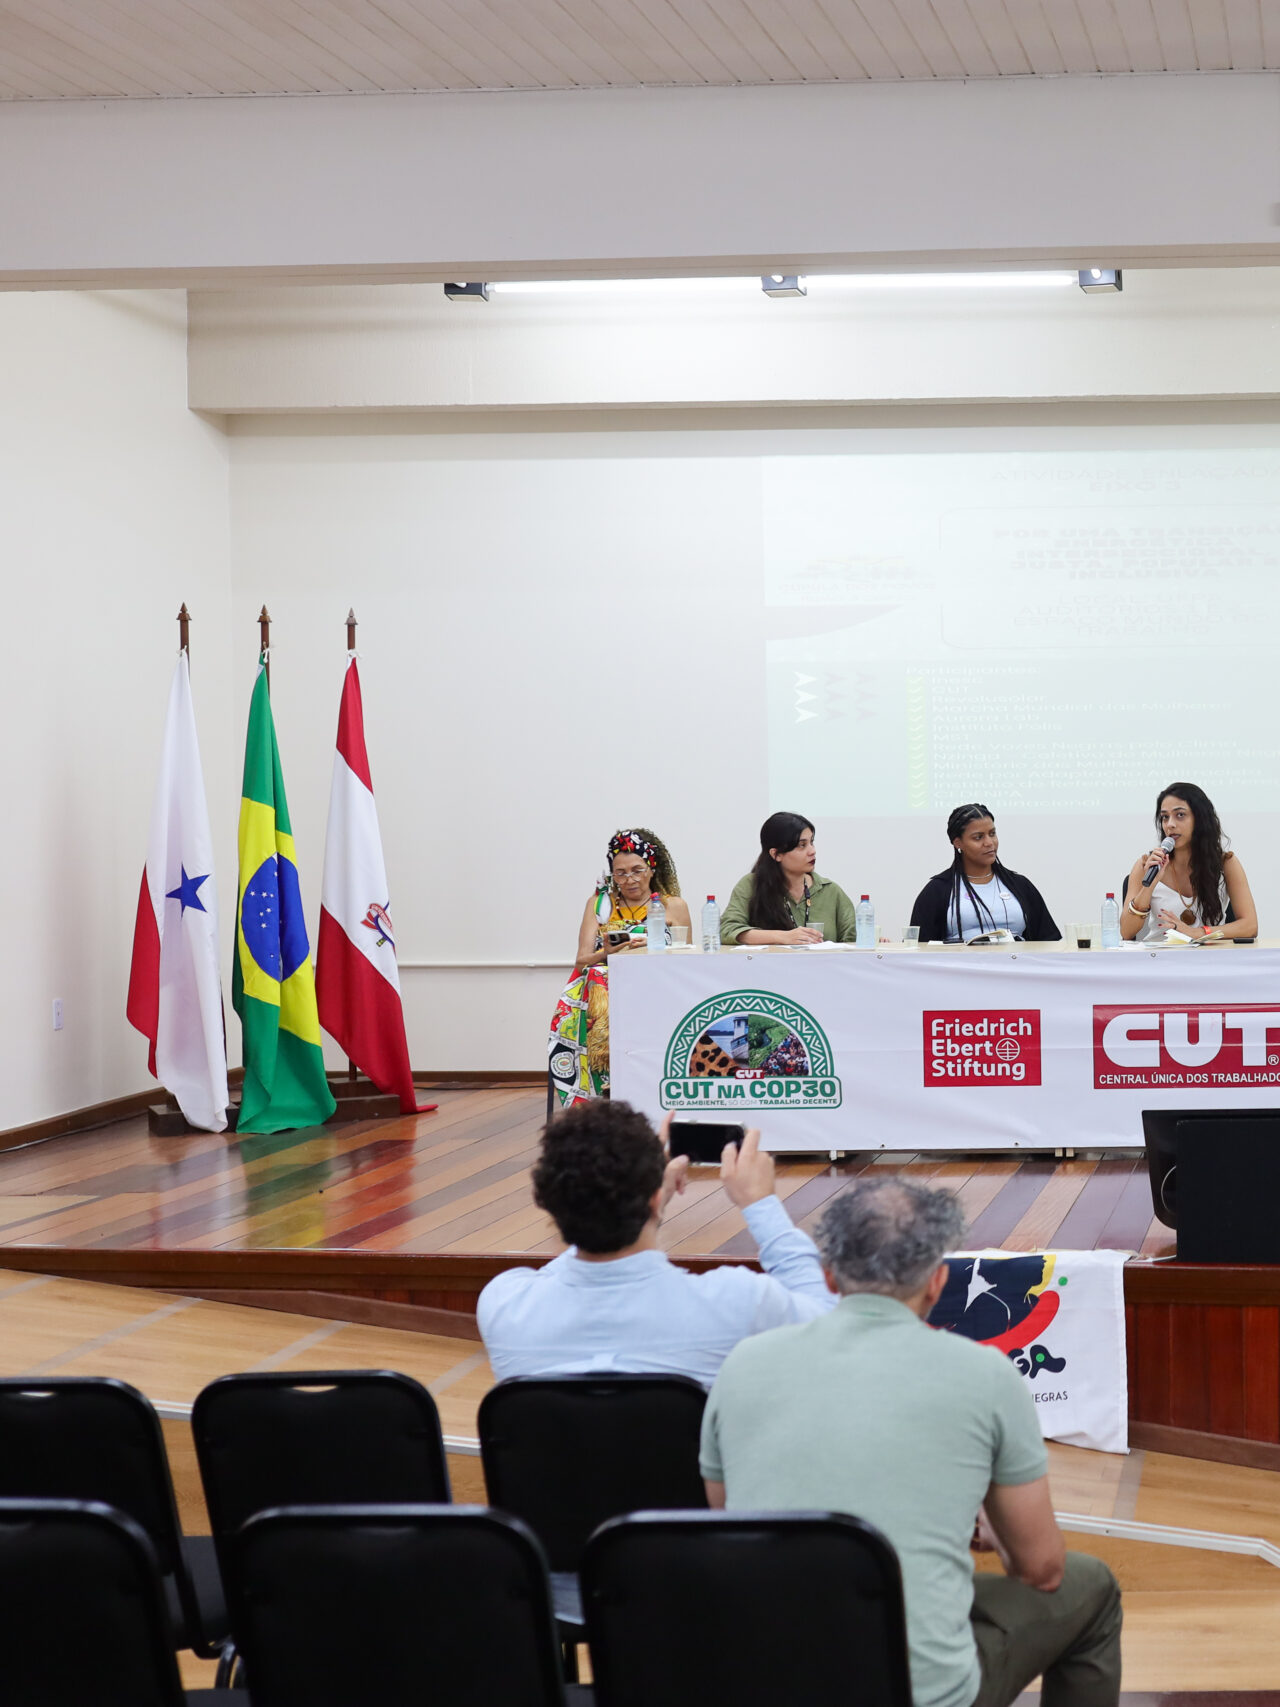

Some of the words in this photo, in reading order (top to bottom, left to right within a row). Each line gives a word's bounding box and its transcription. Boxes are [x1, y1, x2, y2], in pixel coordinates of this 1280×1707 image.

[993, 529, 1051, 539] POR
[1060, 527, 1121, 538] UMA
[1122, 558, 1253, 569] POPULAR
[1069, 568, 1222, 580] INCLUSIVA
[931, 686, 969, 695] CUT
[932, 704, 1008, 713] Marcha
[1013, 703, 1094, 712] Mundial
[933, 723, 1012, 732] Instituto
[933, 743, 983, 751] Rede
[931, 1017, 1032, 1036] Friedrich
[931, 1039, 993, 1056] Ebert
[736, 1069, 764, 1079] CUT
[931, 1058, 1026, 1081] Stiftung
[1099, 1074, 1148, 1084] CENTRAL
[1151, 1072, 1183, 1084] ÚNICA
[1186, 1073, 1208, 1083] DOS
[665, 1081, 714, 1099] CUT
[718, 1085, 746, 1099] NA
[750, 1080, 836, 1098] COP30
[686, 1099, 727, 1107] AMBIENTE,
[1032, 1390, 1068, 1403] EGRAS
